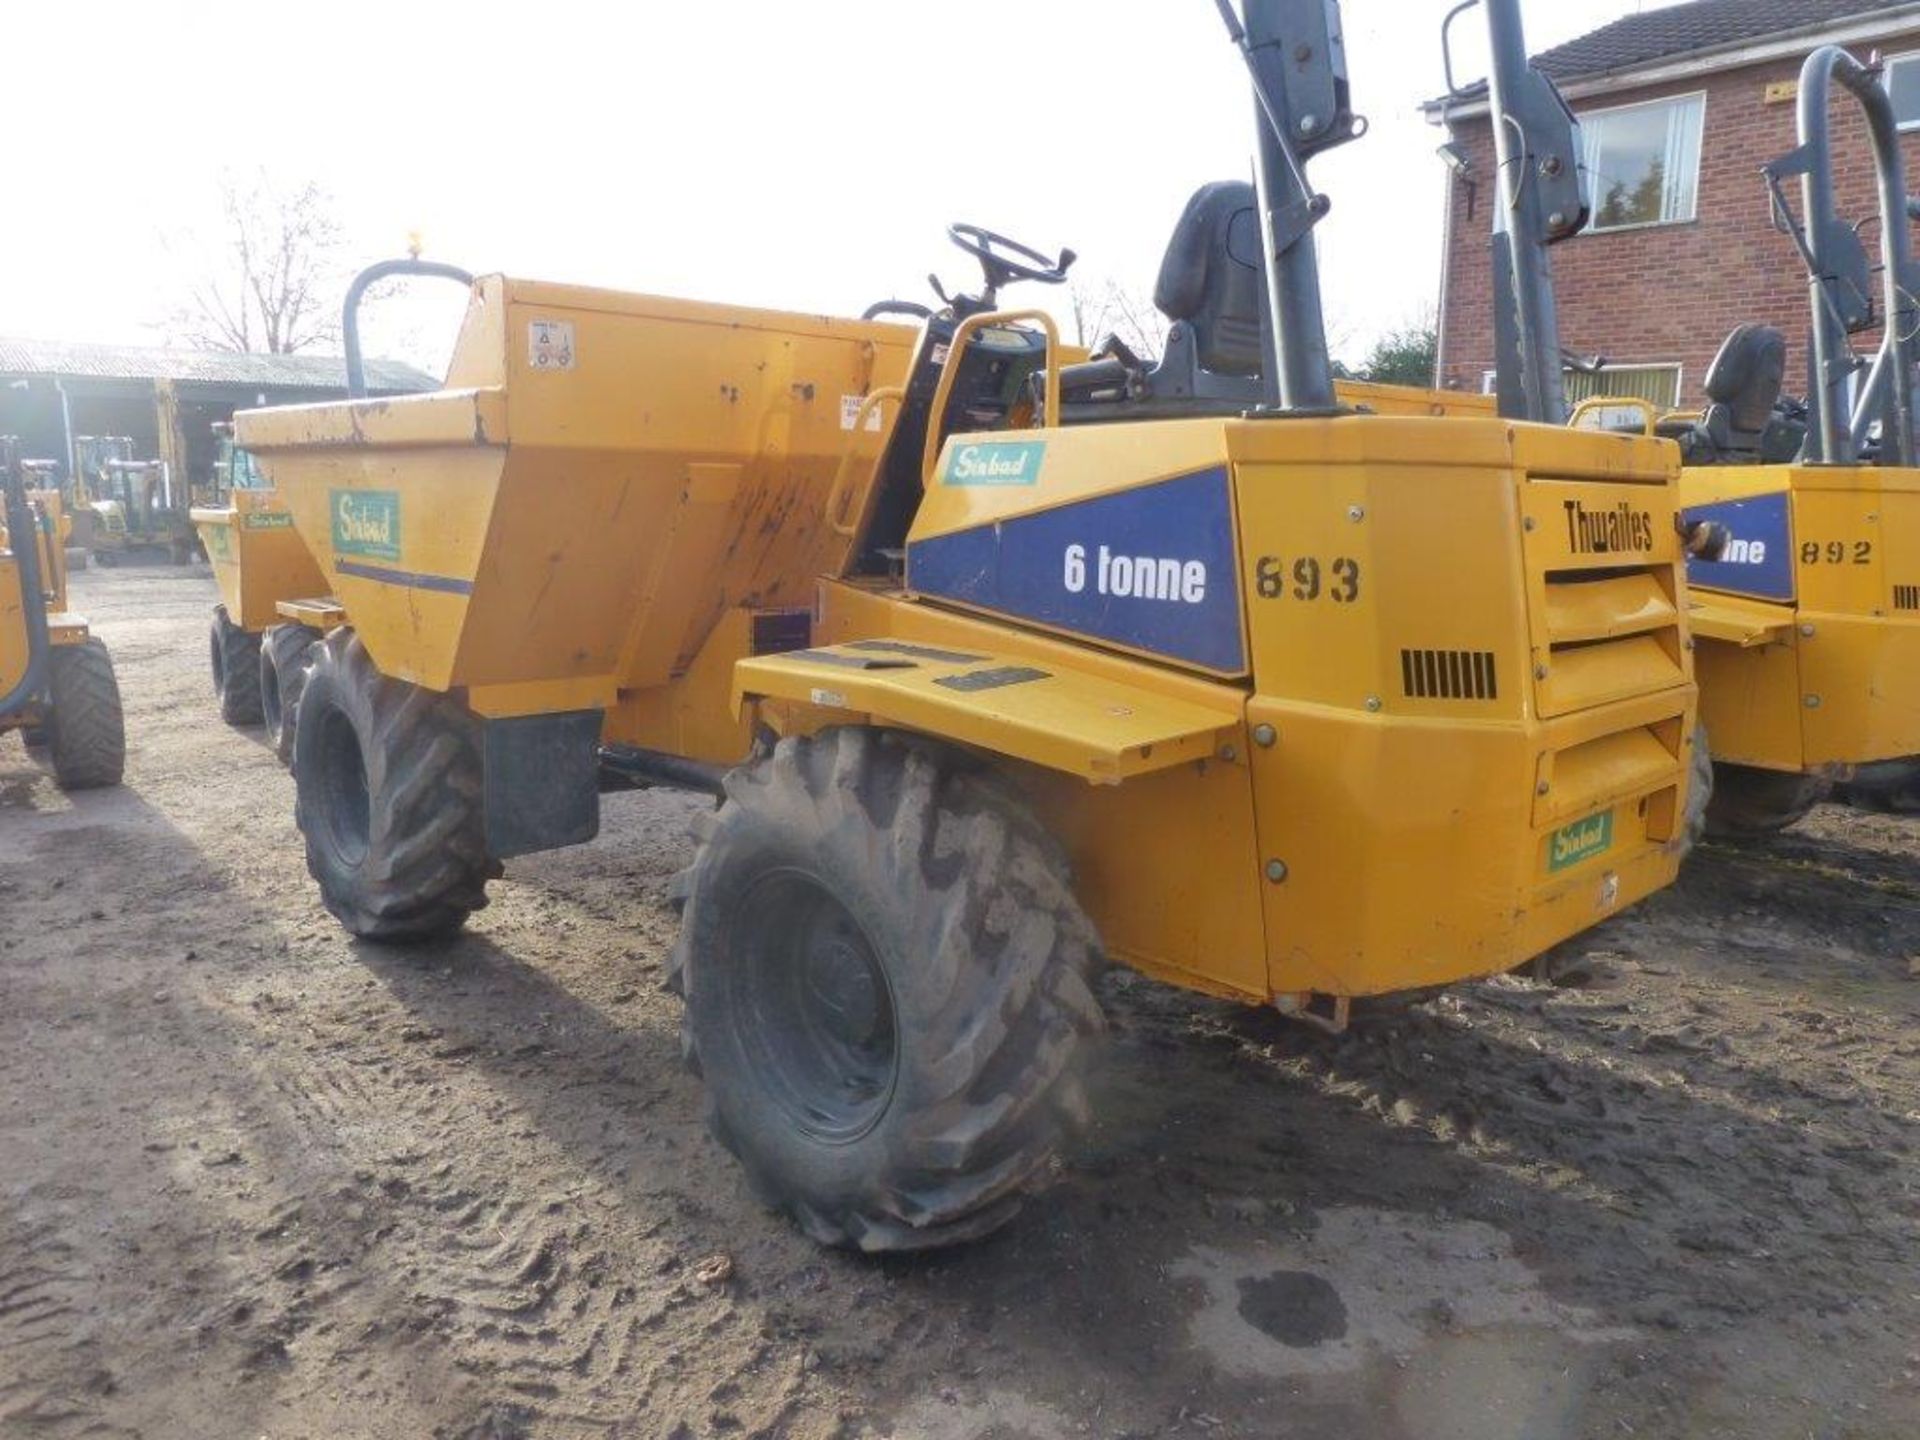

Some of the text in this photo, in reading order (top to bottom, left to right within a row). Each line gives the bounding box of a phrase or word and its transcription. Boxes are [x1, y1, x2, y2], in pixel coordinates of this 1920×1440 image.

[954, 446, 1029, 478] Sinbad
[339, 494, 391, 545] Sinbad
[1564, 500, 1653, 553] Thwaites
[1064, 544, 1206, 603] 6 tonne
[1801, 541, 1871, 565] 892
[1256, 556, 1358, 603] 893
[1554, 815, 1605, 861] Sinbad
